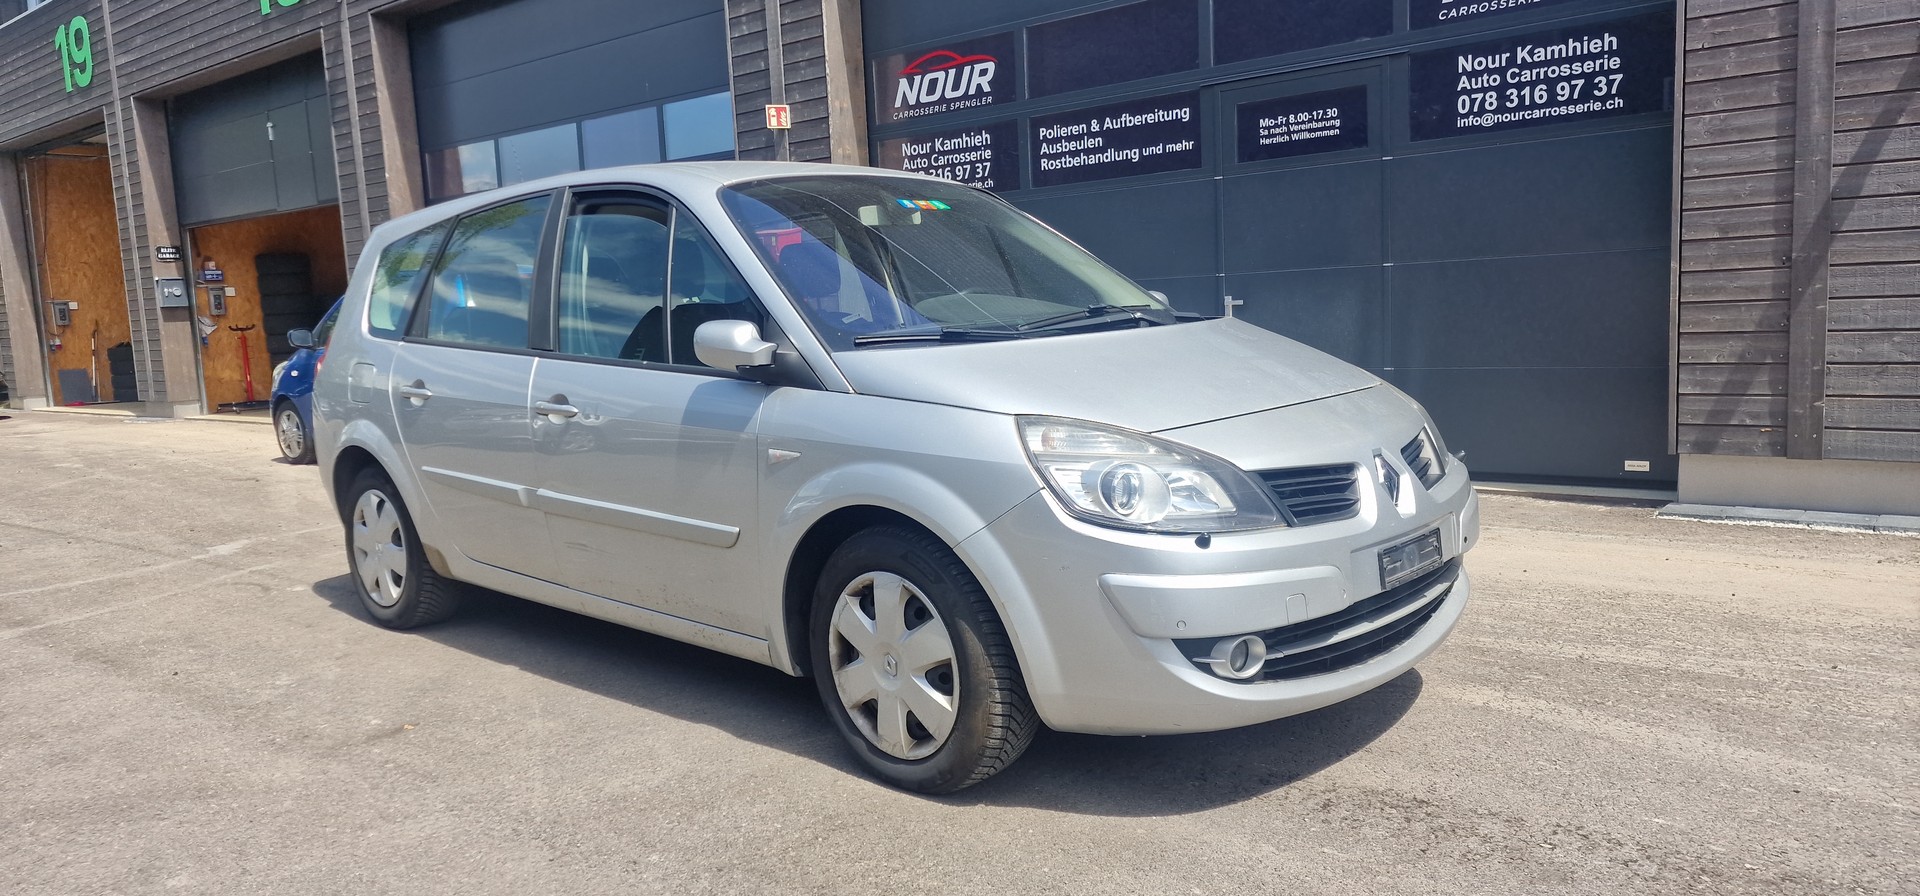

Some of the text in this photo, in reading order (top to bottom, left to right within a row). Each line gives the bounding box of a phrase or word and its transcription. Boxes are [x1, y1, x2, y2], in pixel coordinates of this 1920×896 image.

[1438, 0, 1541, 20] CARROSSER
[55, 15, 93, 92] 19
[1458, 33, 1618, 73] Nour Kamhieh
[894, 61, 996, 108] NOUR
[1457, 55, 1621, 91] Auto Carrosserie
[1457, 73, 1624, 114] 078 316 97 37
[893, 96, 993, 120] CARROSSERIE SPENGLER
[1259, 108, 1338, 128] Mo-Fr 8.00-17.30
[1457, 97, 1624, 128] info@nourcarrosserie.ch
[1039, 107, 1190, 140] Polieren & Aufbereitung
[1259, 119, 1340, 136] Sa nach Vereinbarung
[1260, 128, 1340, 145] Herzlich Willkommen
[901, 130, 991, 157] Nour Kamhieh
[1040, 136, 1103, 155] Ausbeulen
[1041, 140, 1194, 171] Rostbehandlung und mehr
[903, 147, 992, 170] Auto Carrosserie
[955, 164, 971, 180] 97
[975, 162, 991, 178] 37
